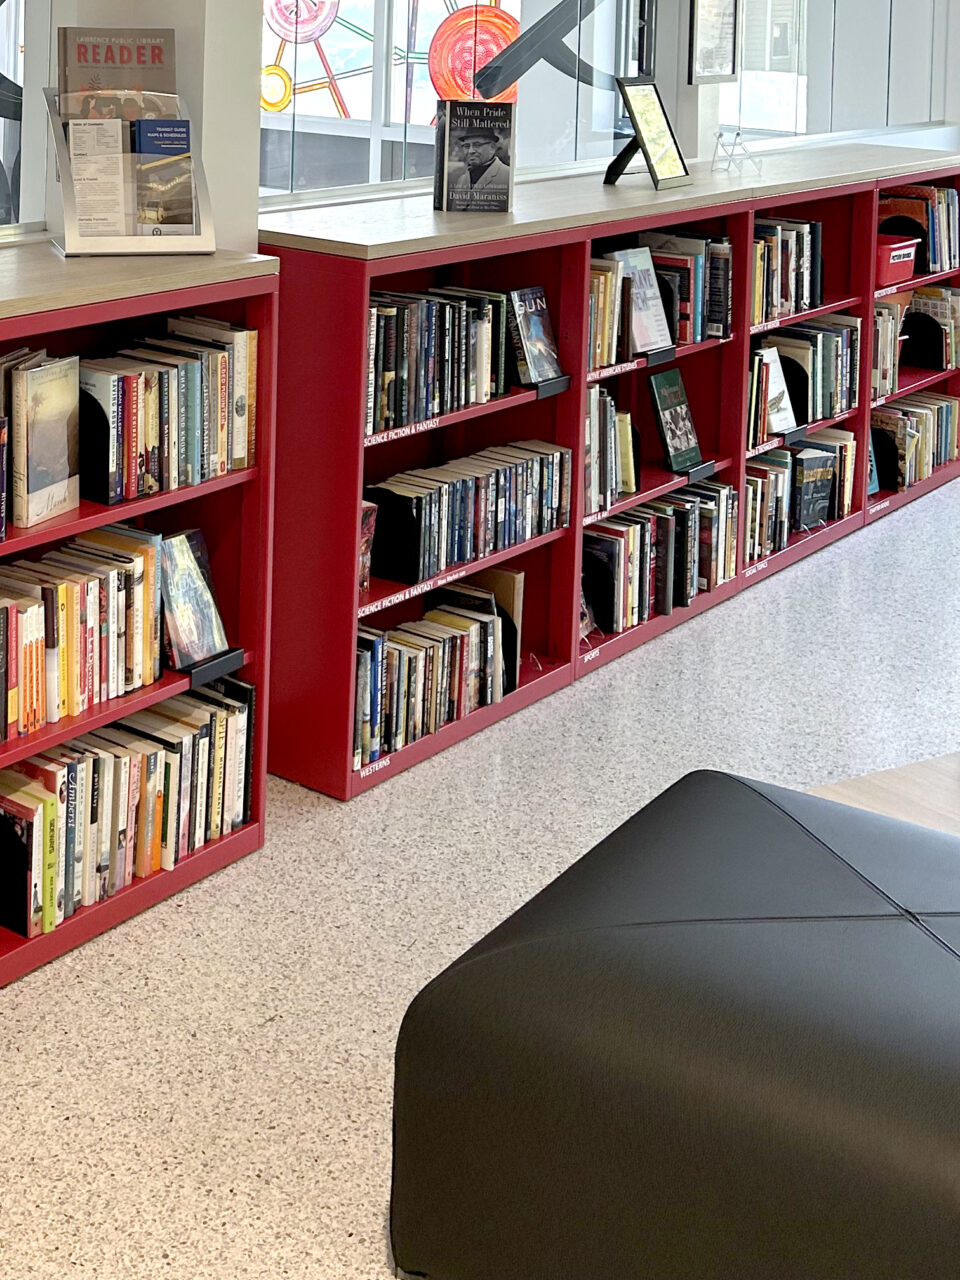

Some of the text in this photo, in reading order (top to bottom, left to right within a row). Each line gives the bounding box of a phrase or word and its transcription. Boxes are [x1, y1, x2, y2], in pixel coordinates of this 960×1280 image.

[77, 44, 164, 65] READER
[456, 106, 506, 117] When Pride
[451, 117, 510, 129] Still Mattered
[449, 190, 508, 201] David Maraniss
[516, 297, 547, 315] GUN
[364, 434, 388, 447] SCIENCE
[389, 427, 410, 440] FICTION
[416, 419, 440, 433] FANTASY
[357, 603, 381, 618] SCIENCE
[382, 593, 404, 608] FICTION
[410, 580, 434, 597] FANTASY
[584, 649, 600, 663] SPORTS
[360, 757, 391, 778] WESTERNS
